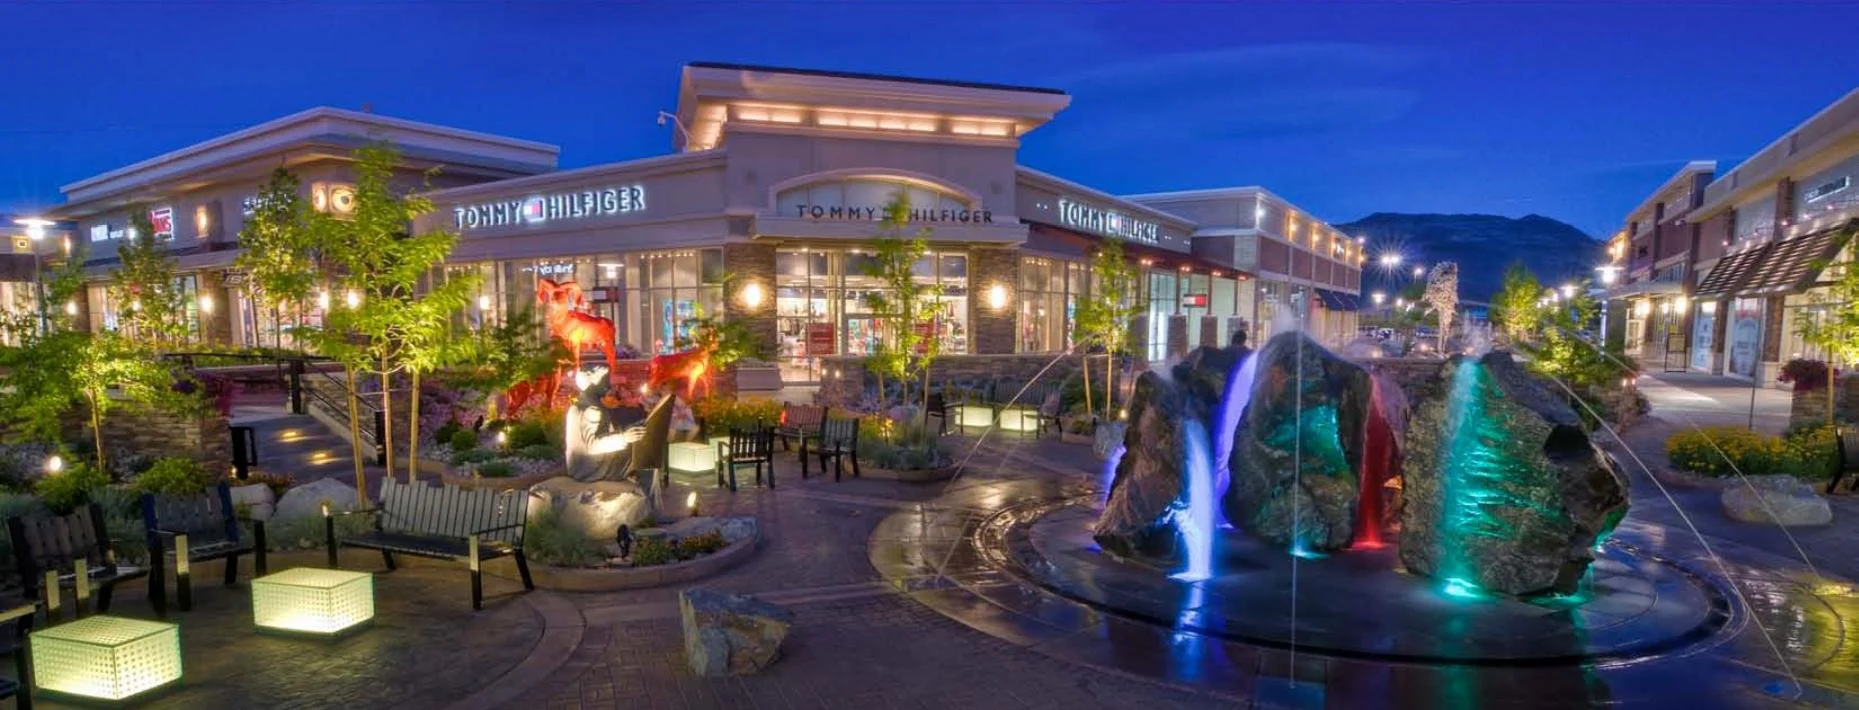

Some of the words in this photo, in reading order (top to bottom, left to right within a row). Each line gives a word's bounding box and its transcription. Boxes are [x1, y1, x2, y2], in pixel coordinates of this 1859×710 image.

[454, 201, 521, 229] TOMMY
[548, 185, 646, 219] HILFIGER
[796, 204, 875, 220] TOMMY
[908, 208, 993, 224] HILFIGER
[1059, 199, 1103, 232] TOMMY
